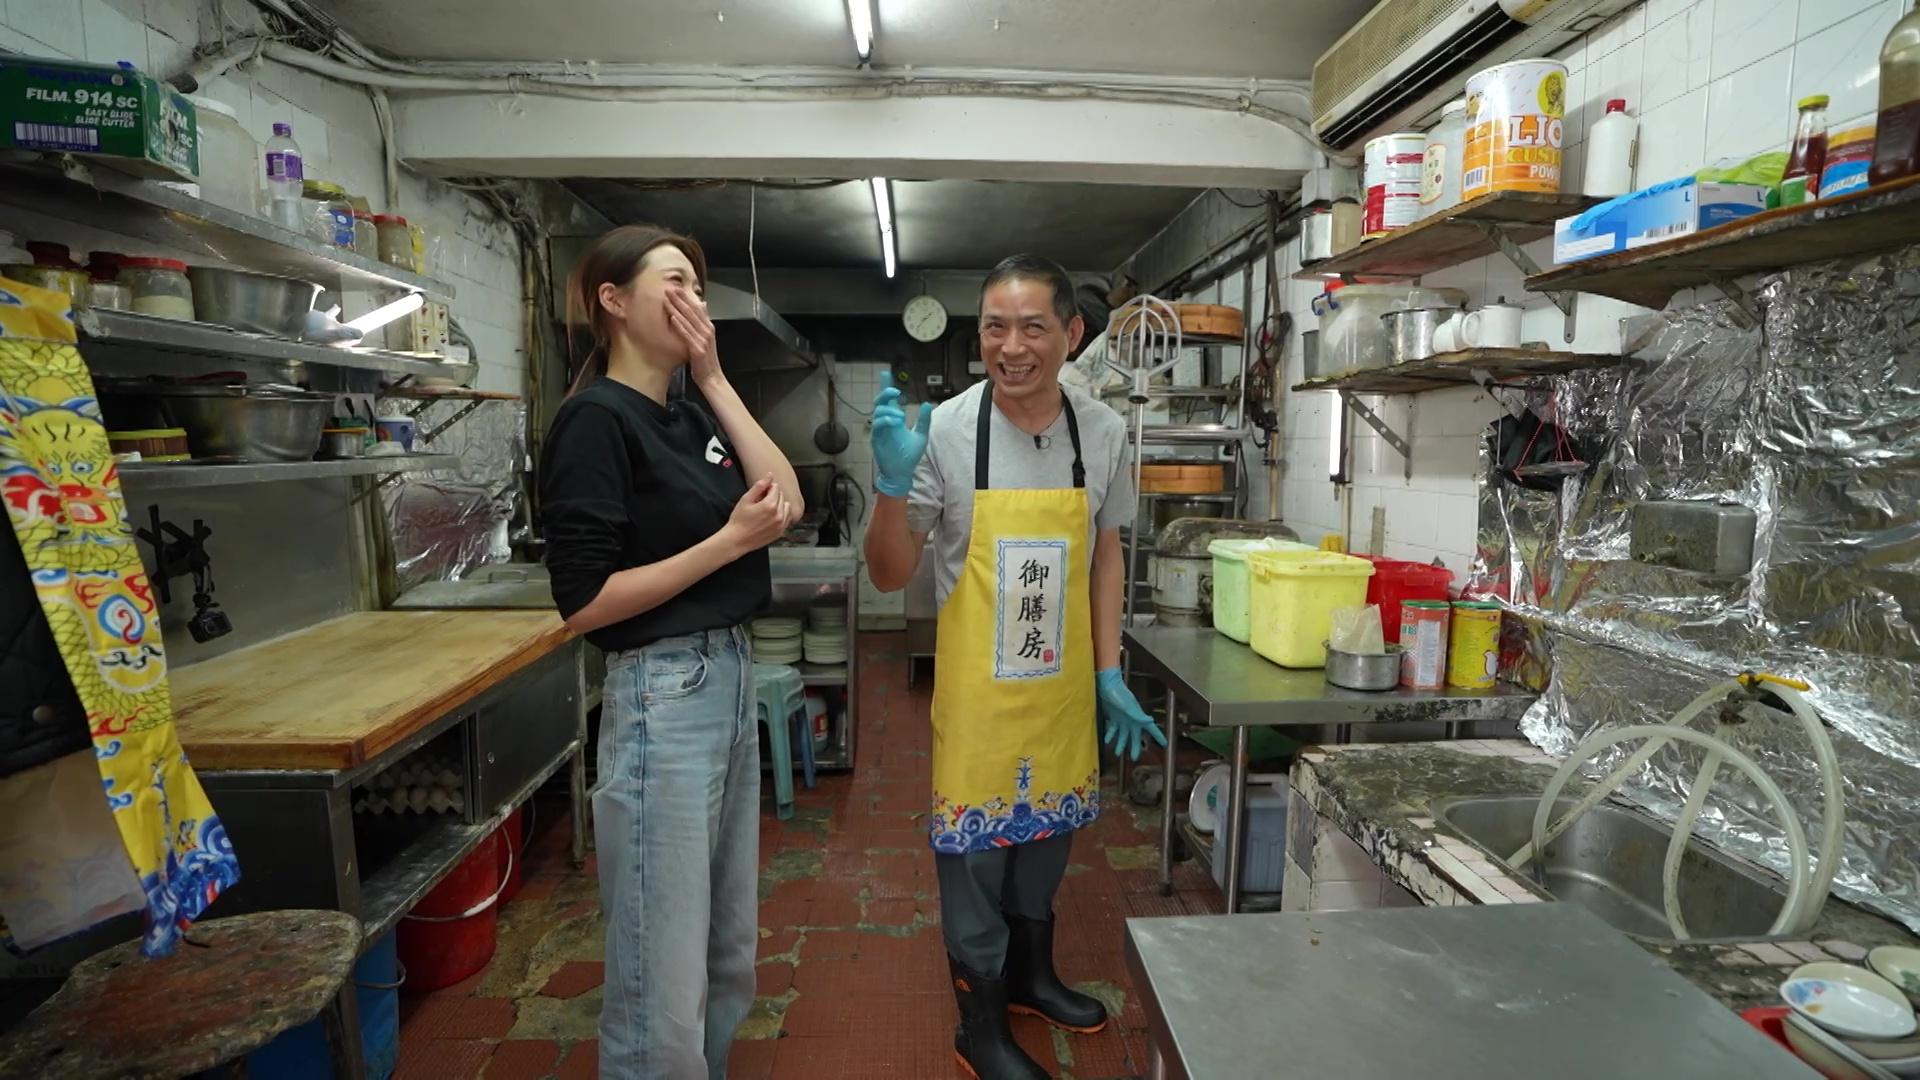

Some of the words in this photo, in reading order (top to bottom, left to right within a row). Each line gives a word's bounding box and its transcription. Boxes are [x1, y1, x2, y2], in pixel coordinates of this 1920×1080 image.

[74, 89, 113, 108] 914
[116, 96, 138, 109] SC
[85, 107, 108, 117] EASY
[75, 115, 100, 125] SLIDE
[102, 118, 135, 128] CUTTER
[1685, 191, 1691, 202] L
[1757, 191, 1763, 202] L
[1017, 559, 1050, 660] 御膳房
